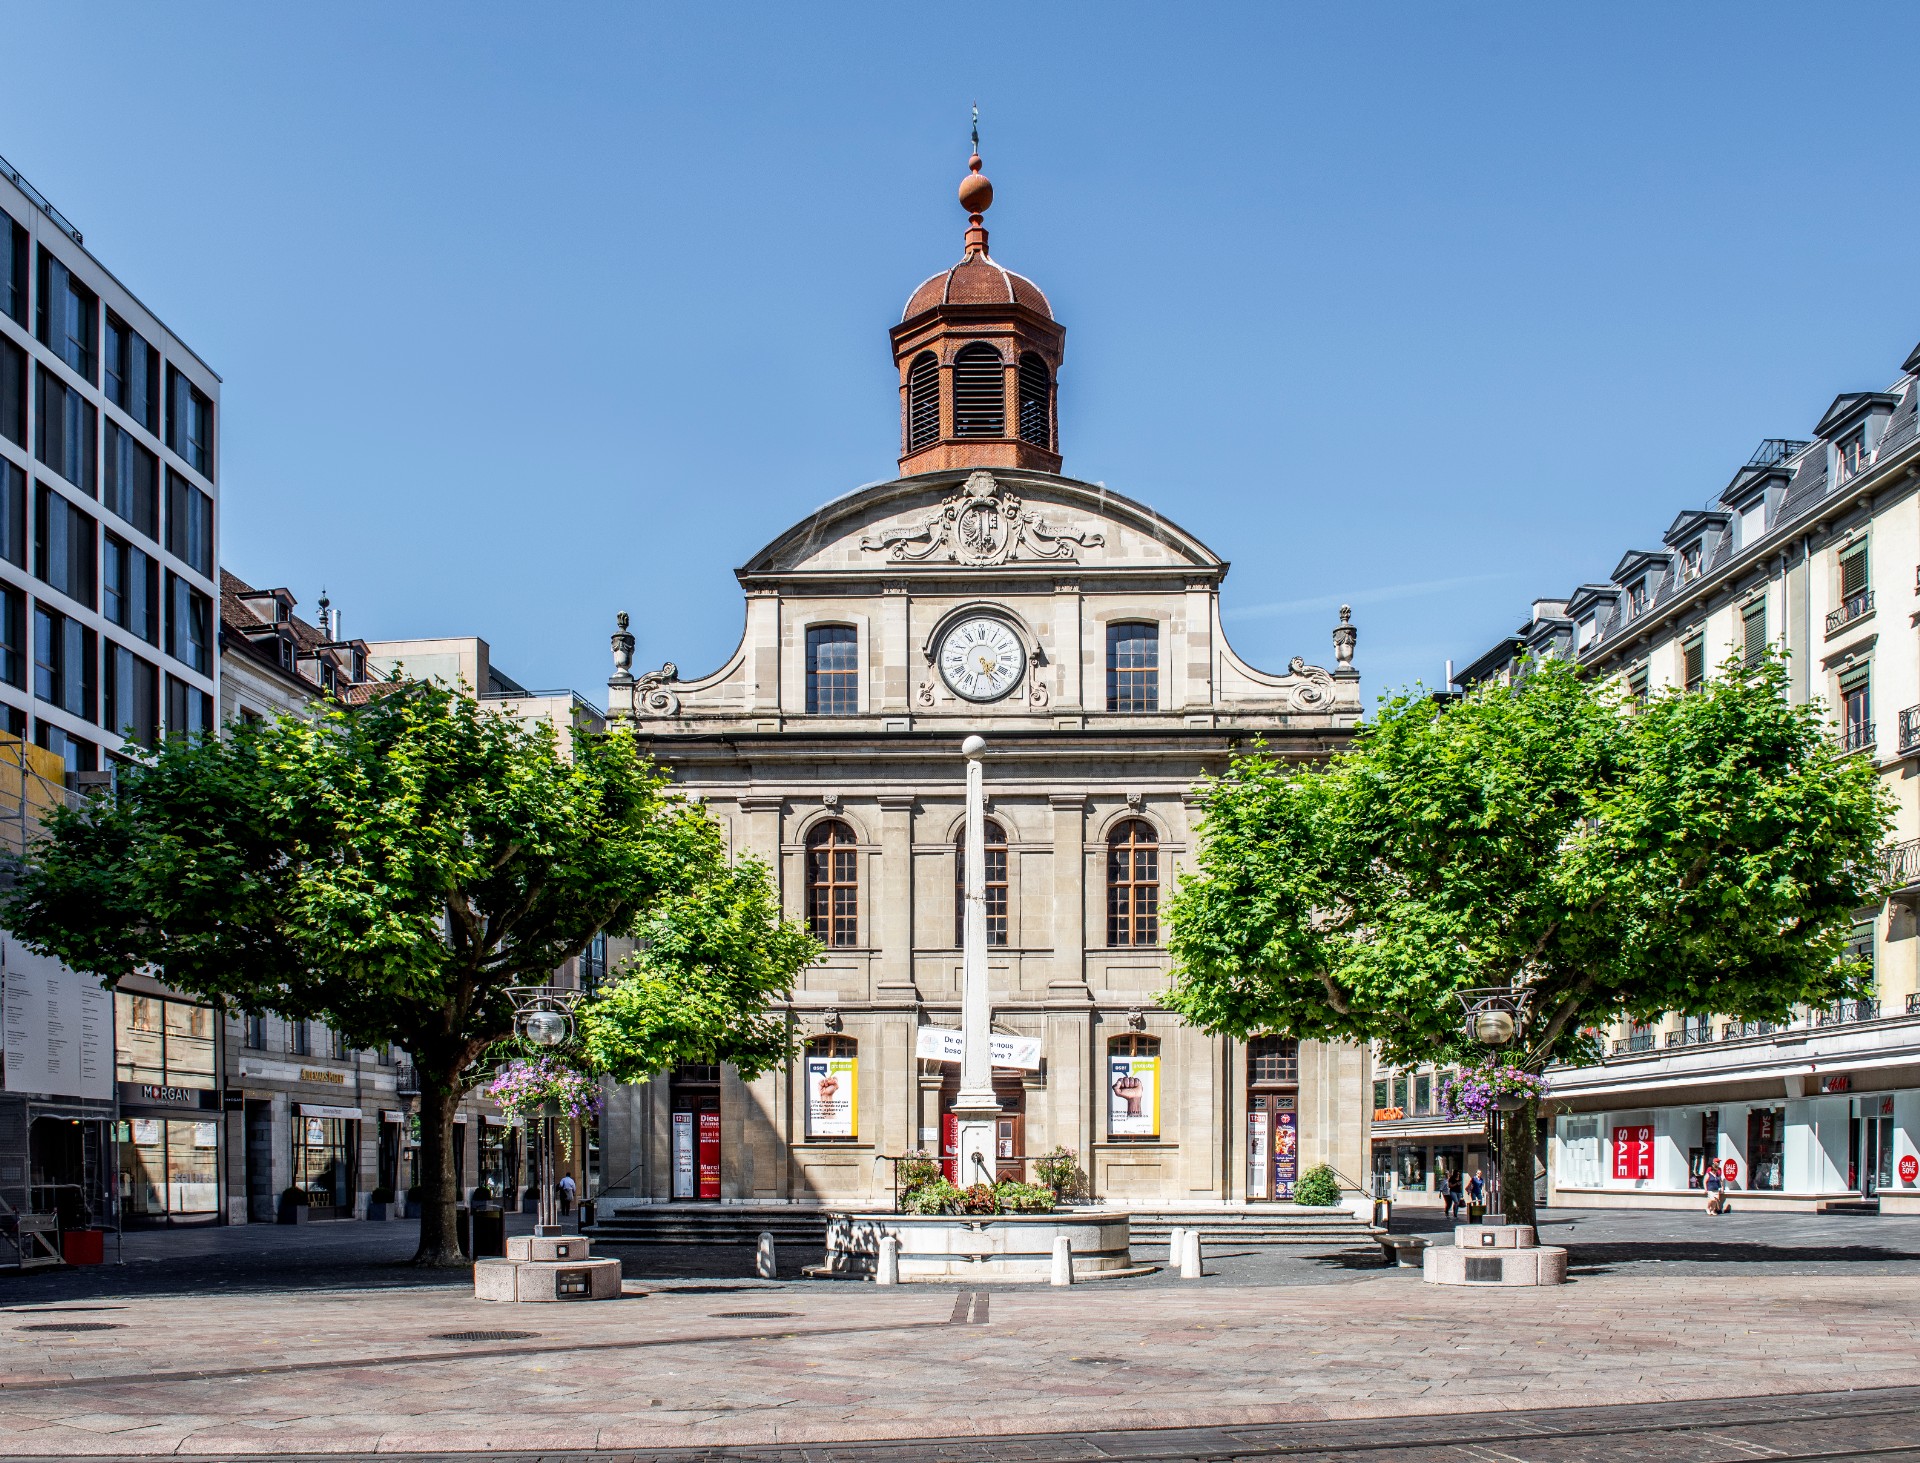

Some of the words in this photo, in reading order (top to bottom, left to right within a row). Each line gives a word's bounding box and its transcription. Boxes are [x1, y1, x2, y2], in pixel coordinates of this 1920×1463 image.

[944, 1046, 962, 1054] beso
[990, 1042, 1014, 1050] s-nous
[1762, 1115, 1771, 1138] SALE
[1618, 1129, 1628, 1176] SALE
[1638, 1128, 1648, 1176] SALE
